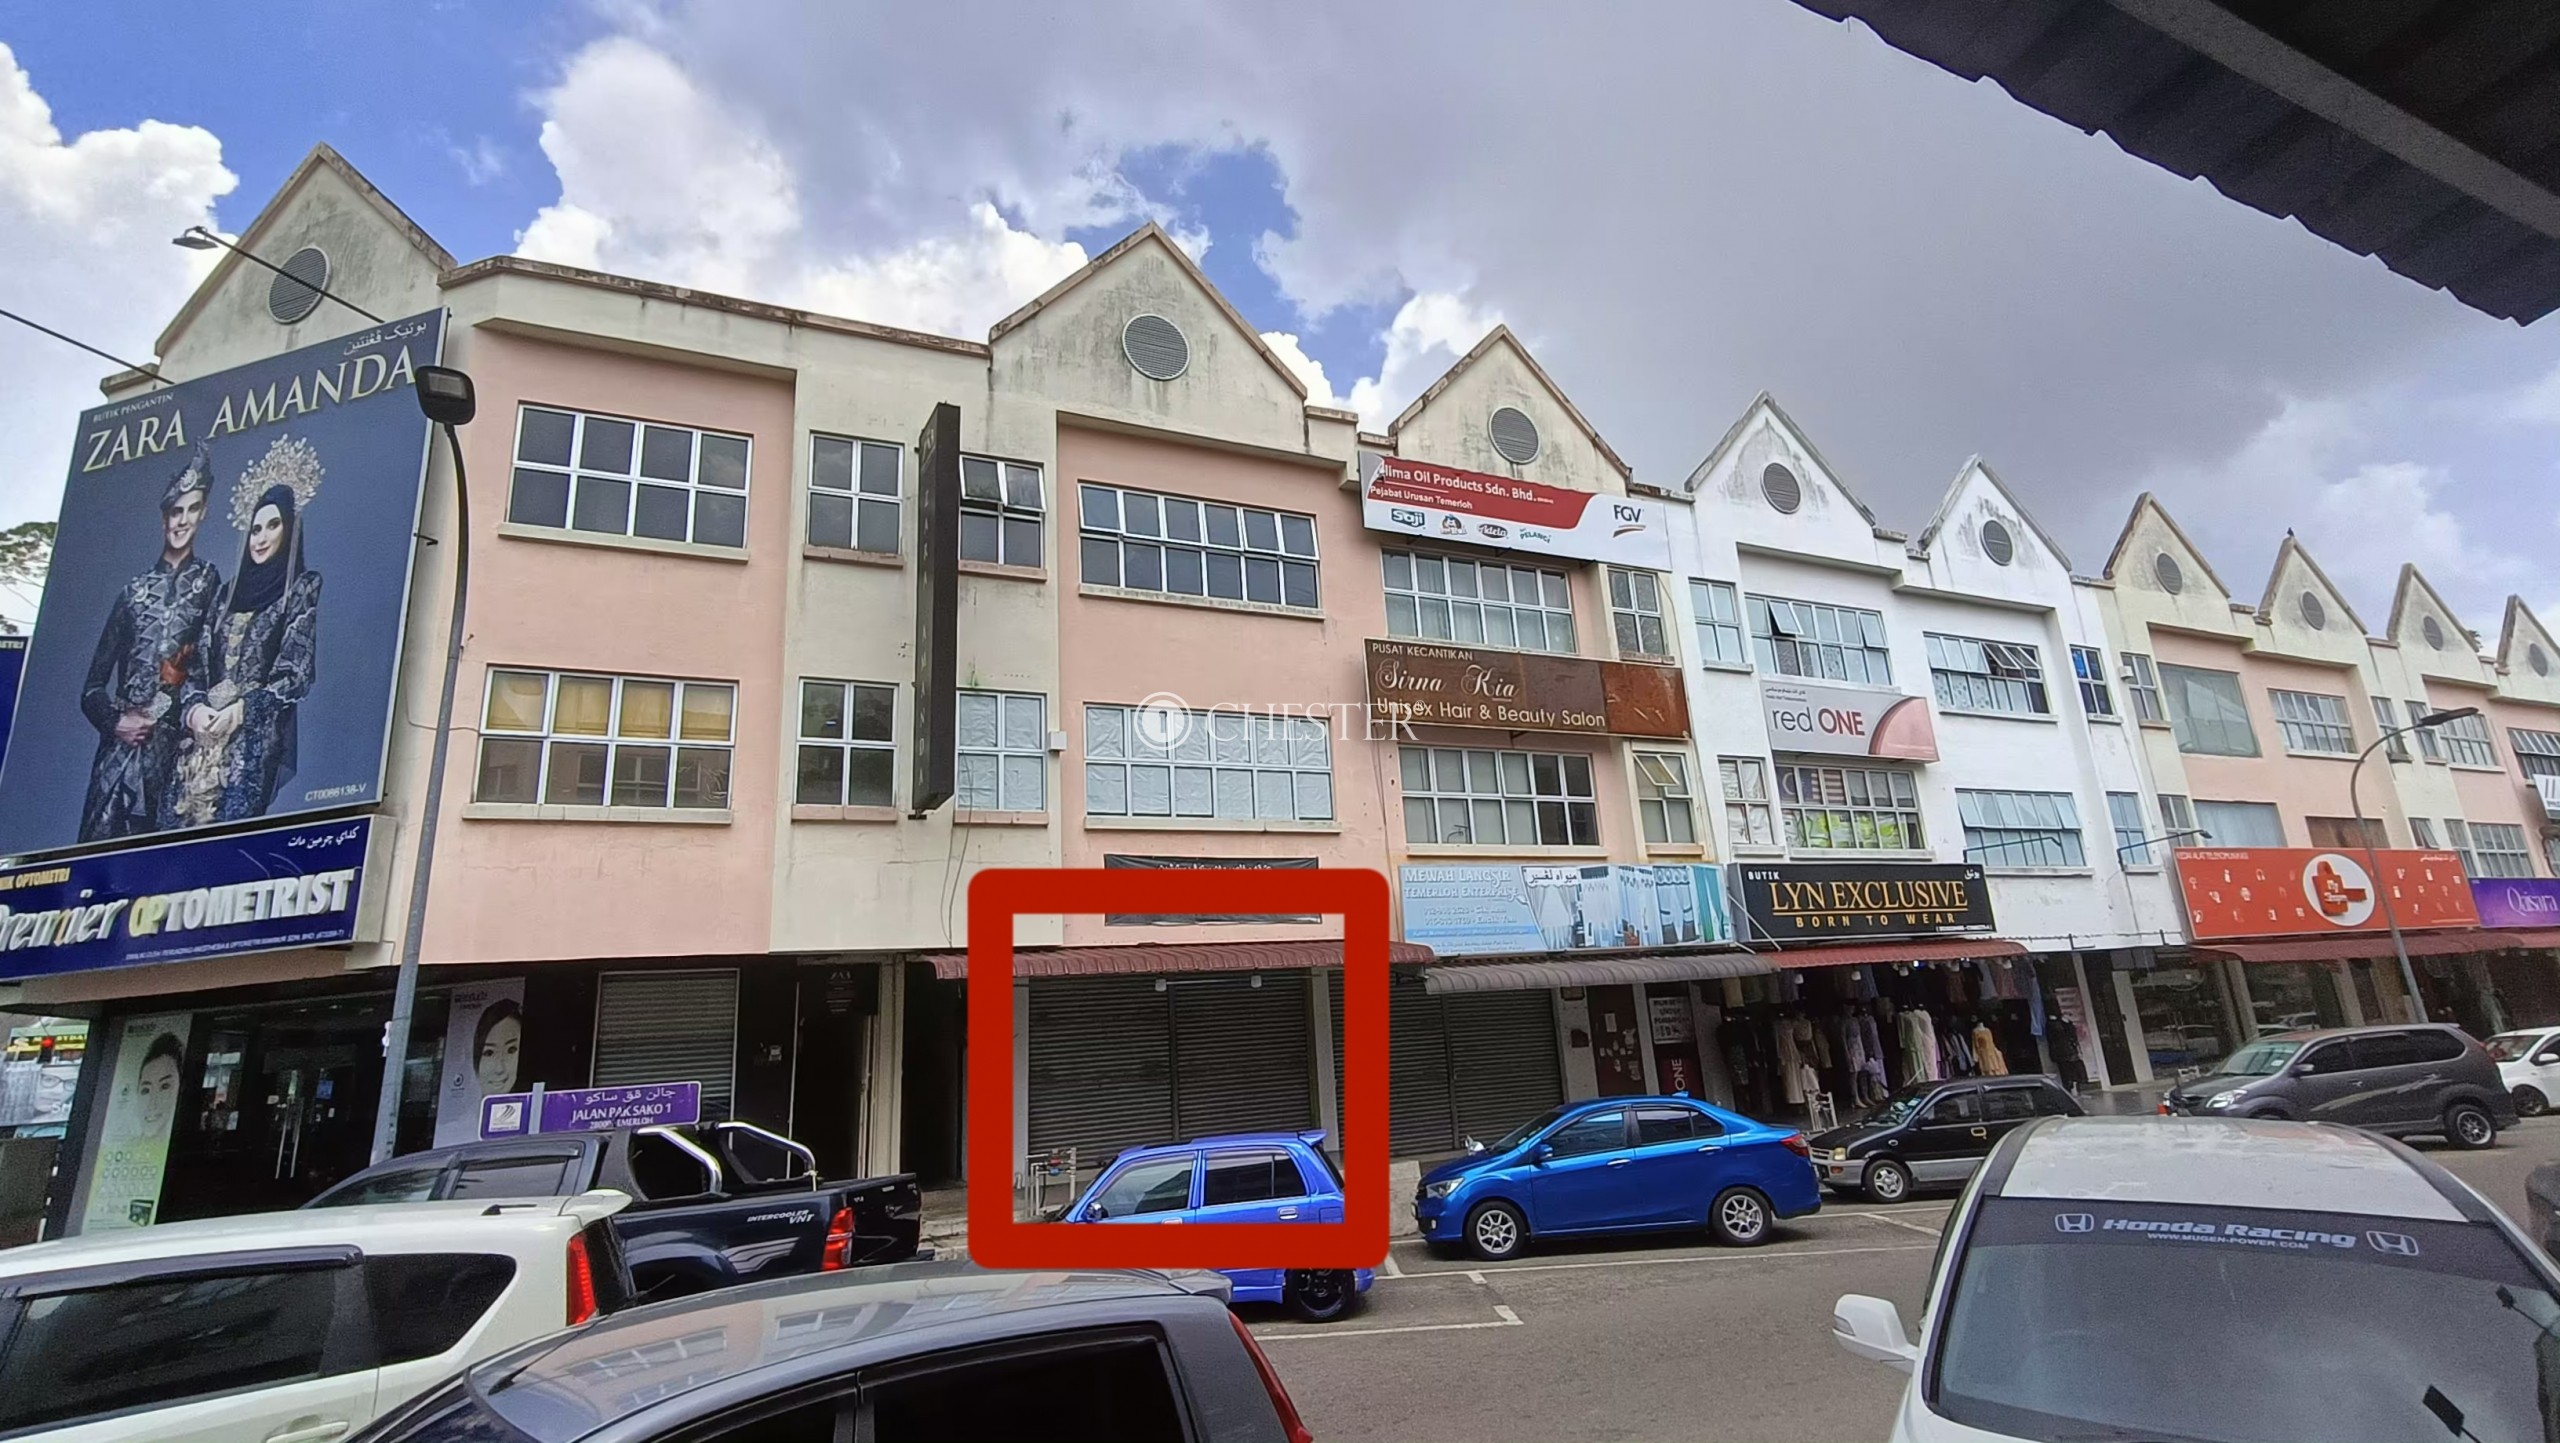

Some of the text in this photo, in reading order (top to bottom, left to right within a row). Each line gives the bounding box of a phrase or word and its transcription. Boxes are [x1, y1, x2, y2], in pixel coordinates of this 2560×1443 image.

[82, 345, 417, 473] ZARA AMANDA
[93, 392, 174, 423] BUTIK PENGANTIN
[1413, 469, 1431, 484] Oil
[1433, 473, 1483, 492] Products
[1485, 481, 1510, 498] Sdn.
[1512, 487, 1537, 502] Bhd.
[1370, 485, 1473, 510] Pejabat Urusan Temerloh
[1392, 508, 1425, 527] Saji
[1613, 504, 1642, 523] FGV
[1372, 643, 1473, 661] PUSAT KECANTIKAN
[1375, 658, 1520, 699] Sirna Kia
[1377, 697, 1606, 727] Unisex Hair & Beauty Salon
[1772, 707, 1866, 736] red ONE
[1405, 868, 1512, 888] MEWAH LANGSIR
[1748, 871, 1780, 881] BUTIK
[128, 868, 356, 938] OPTOMETRIST
[1404, 886, 1519, 902] TEMERLOH ENTERPRISE
[1769, 880, 1968, 910] LYN EXCLUSIVE
[1796, 913, 1955, 928] BORN TO WEAR
[1671, 1058, 1686, 1091] ONE
[571, 1102, 672, 1123] JALAN PAK SAKO 1
[615, 1116, 654, 1128] EMERLOH
[747, 1209, 809, 1223] INTERCOOLER
[789, 1213, 815, 1224] VNT
[2102, 1218, 2357, 1249] Honda Racing
[2146, 1232, 2310, 1250] WWW.MUGEN-POWER.COM
